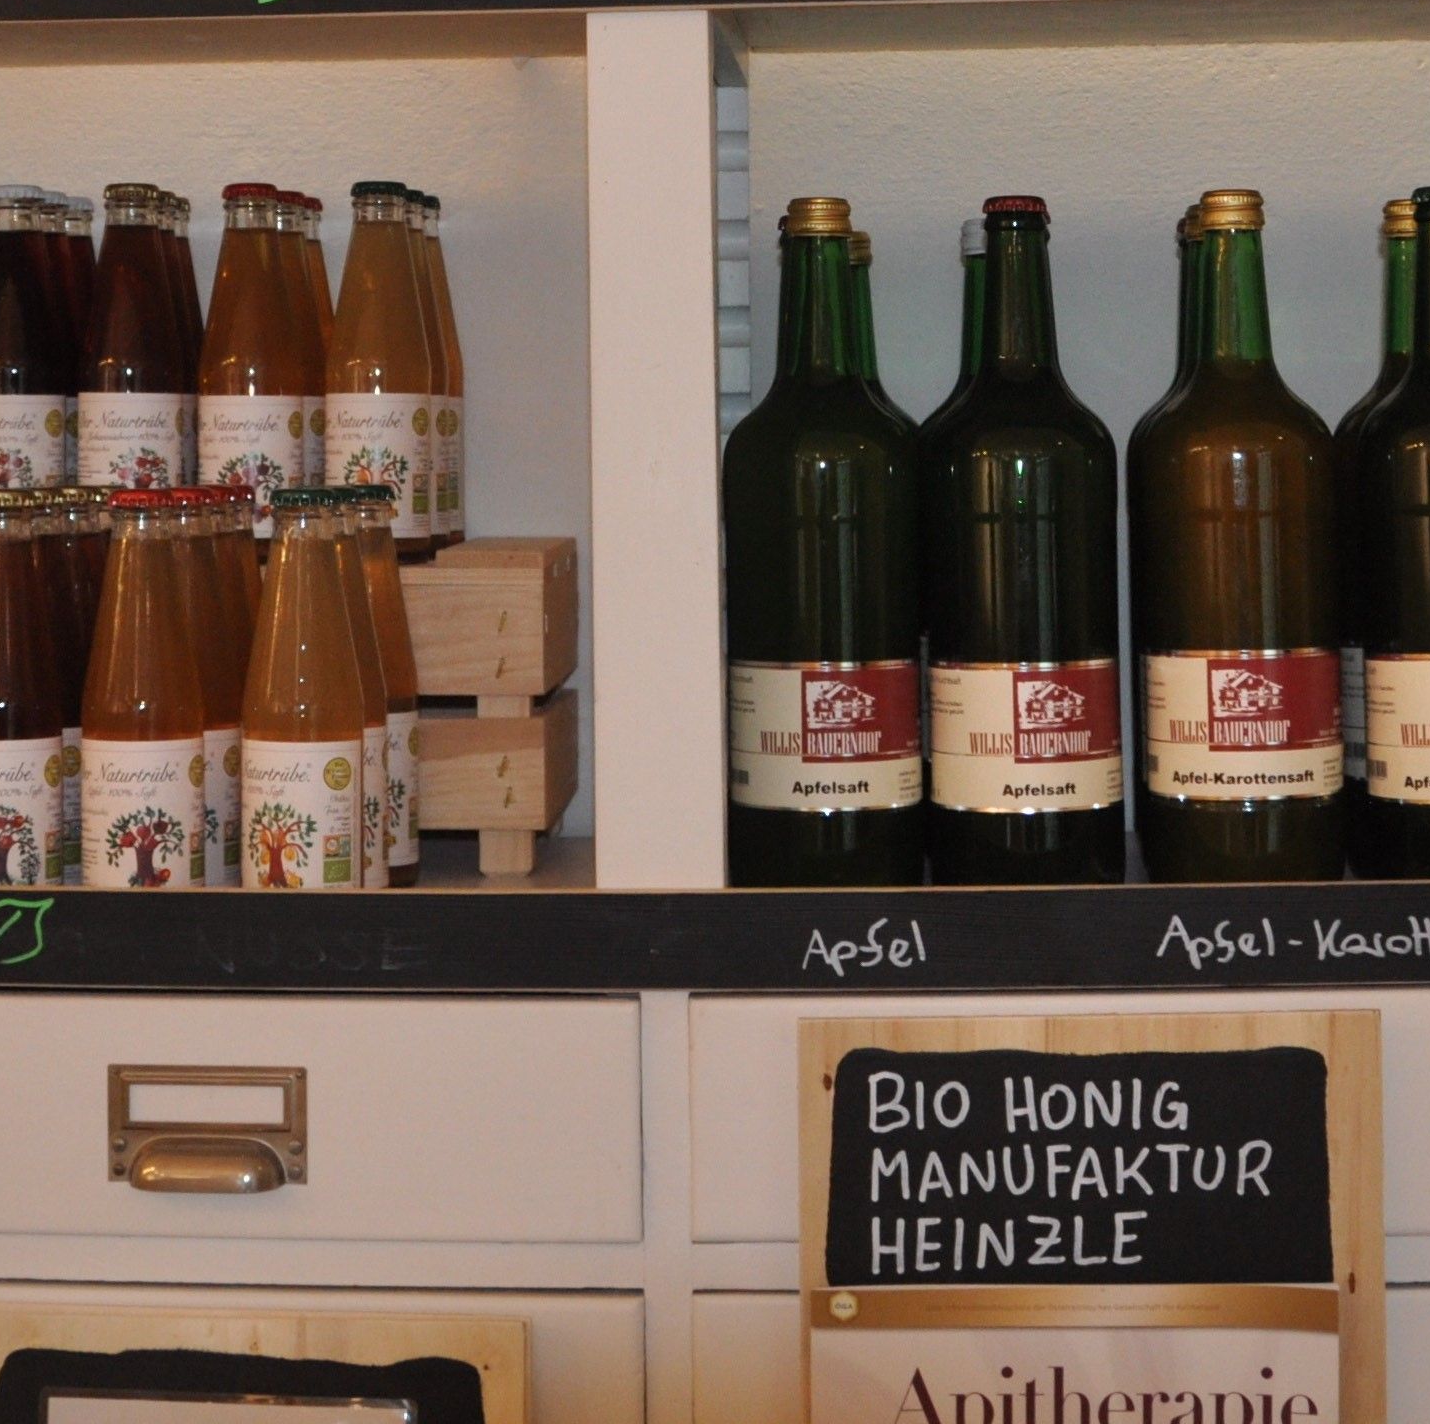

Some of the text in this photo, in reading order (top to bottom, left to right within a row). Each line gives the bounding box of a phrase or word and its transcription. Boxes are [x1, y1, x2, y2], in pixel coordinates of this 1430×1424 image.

[761, 731, 881, 755] WILLIS BAUERNHOF
[970, 730, 1091, 755] WILLIS BAUERNHOF
[1170, 719, 1290, 744] WILLIS BAUERNHOF
[792, 781, 869, 796] Apfelsaft
[1173, 770, 1314, 785] Apfel-Karottensaft
[1003, 783, 1076, 798] Apfelsaft
[801, 918, 926, 976] Apfel
[868, 1071, 1189, 1133] BIO HONIG
[870, 1139, 1272, 1203] MANUFAKTUR
[871, 1211, 1148, 1275] HEINZLE
